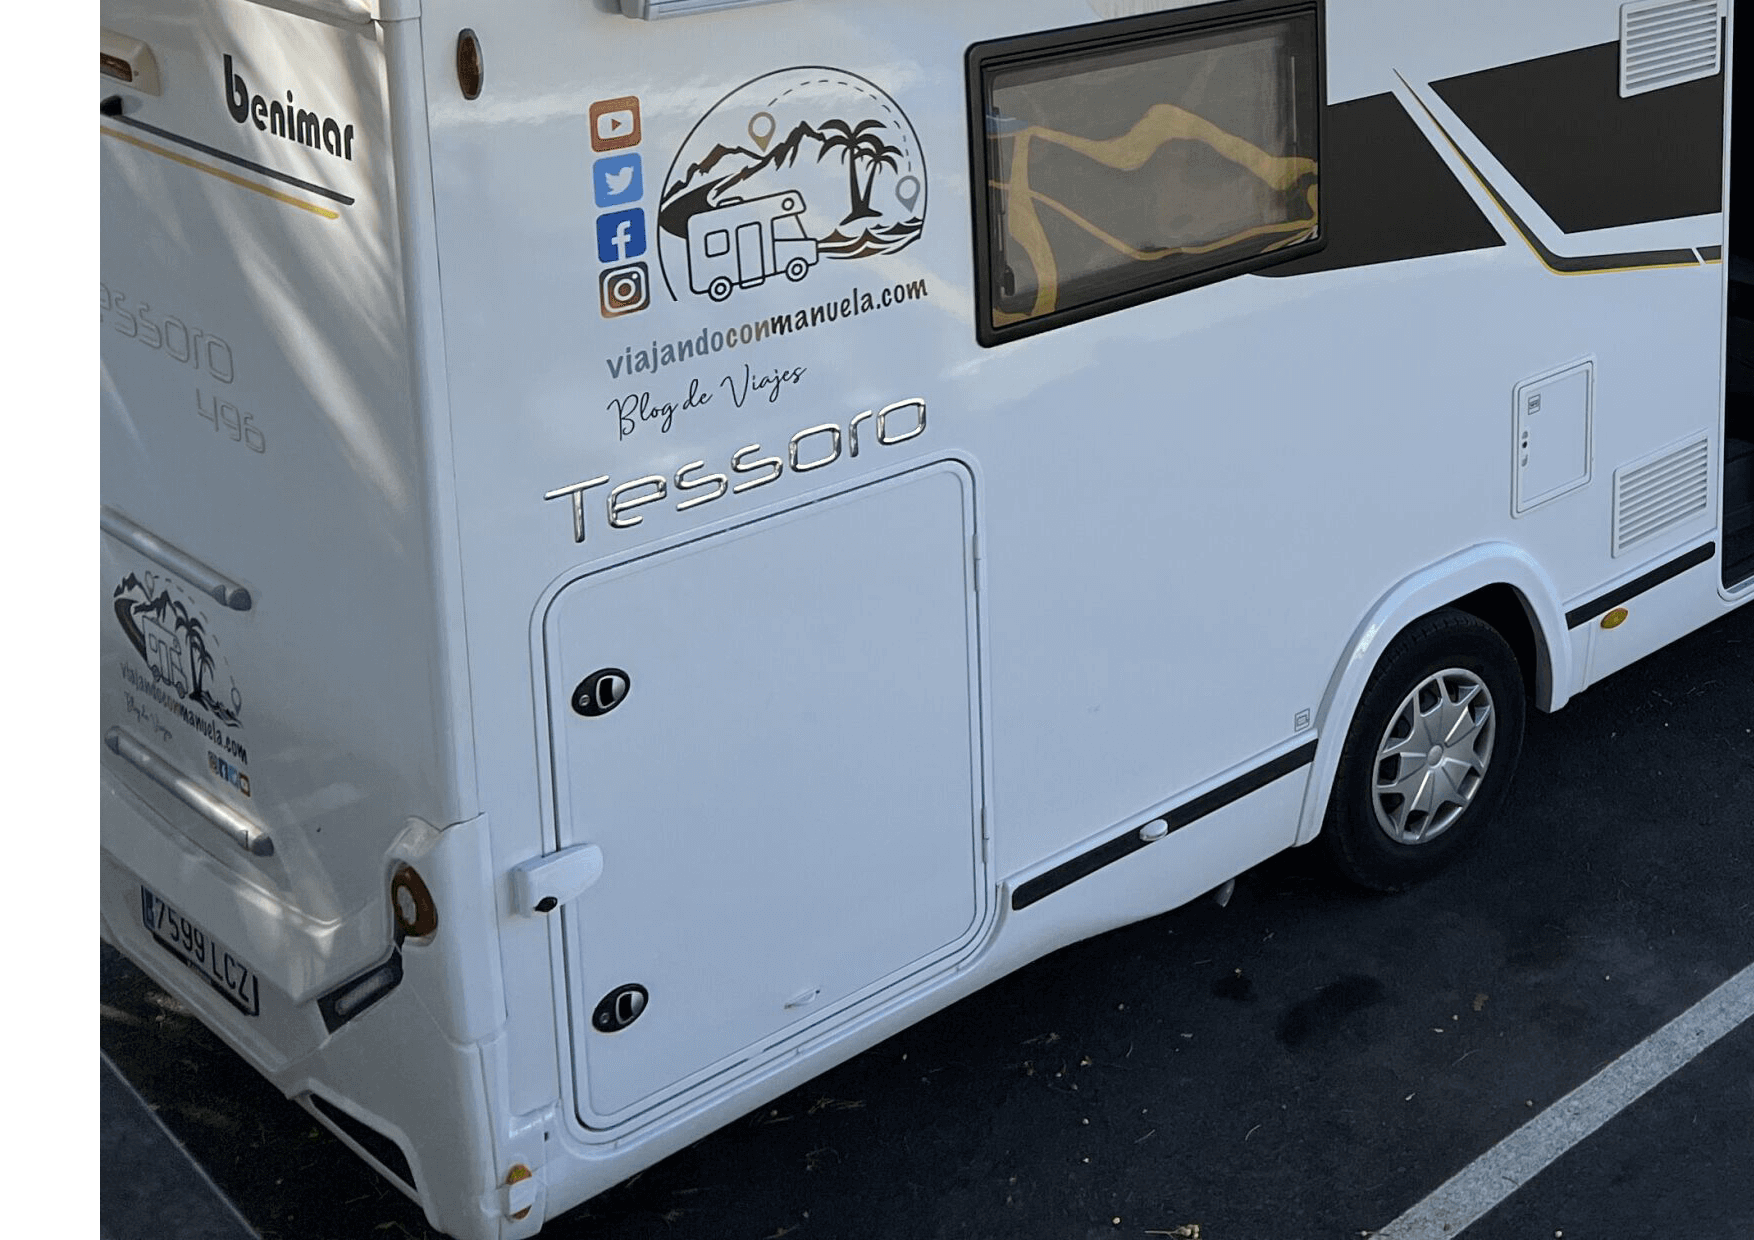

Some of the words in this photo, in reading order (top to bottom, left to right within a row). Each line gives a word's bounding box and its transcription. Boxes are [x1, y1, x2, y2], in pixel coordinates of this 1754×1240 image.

[223, 53, 354, 161] benimar
[606, 277, 929, 379] viajandoconmanuela.com
[196, 387, 266, 455] 496
[606, 391, 678, 442] Blog
[682, 378, 714, 410] de
[720, 363, 808, 408] Viajes
[543, 397, 927, 544] Tessoro
[155, 897, 205, 964] 7599
[211, 940, 249, 1003] LCZ
